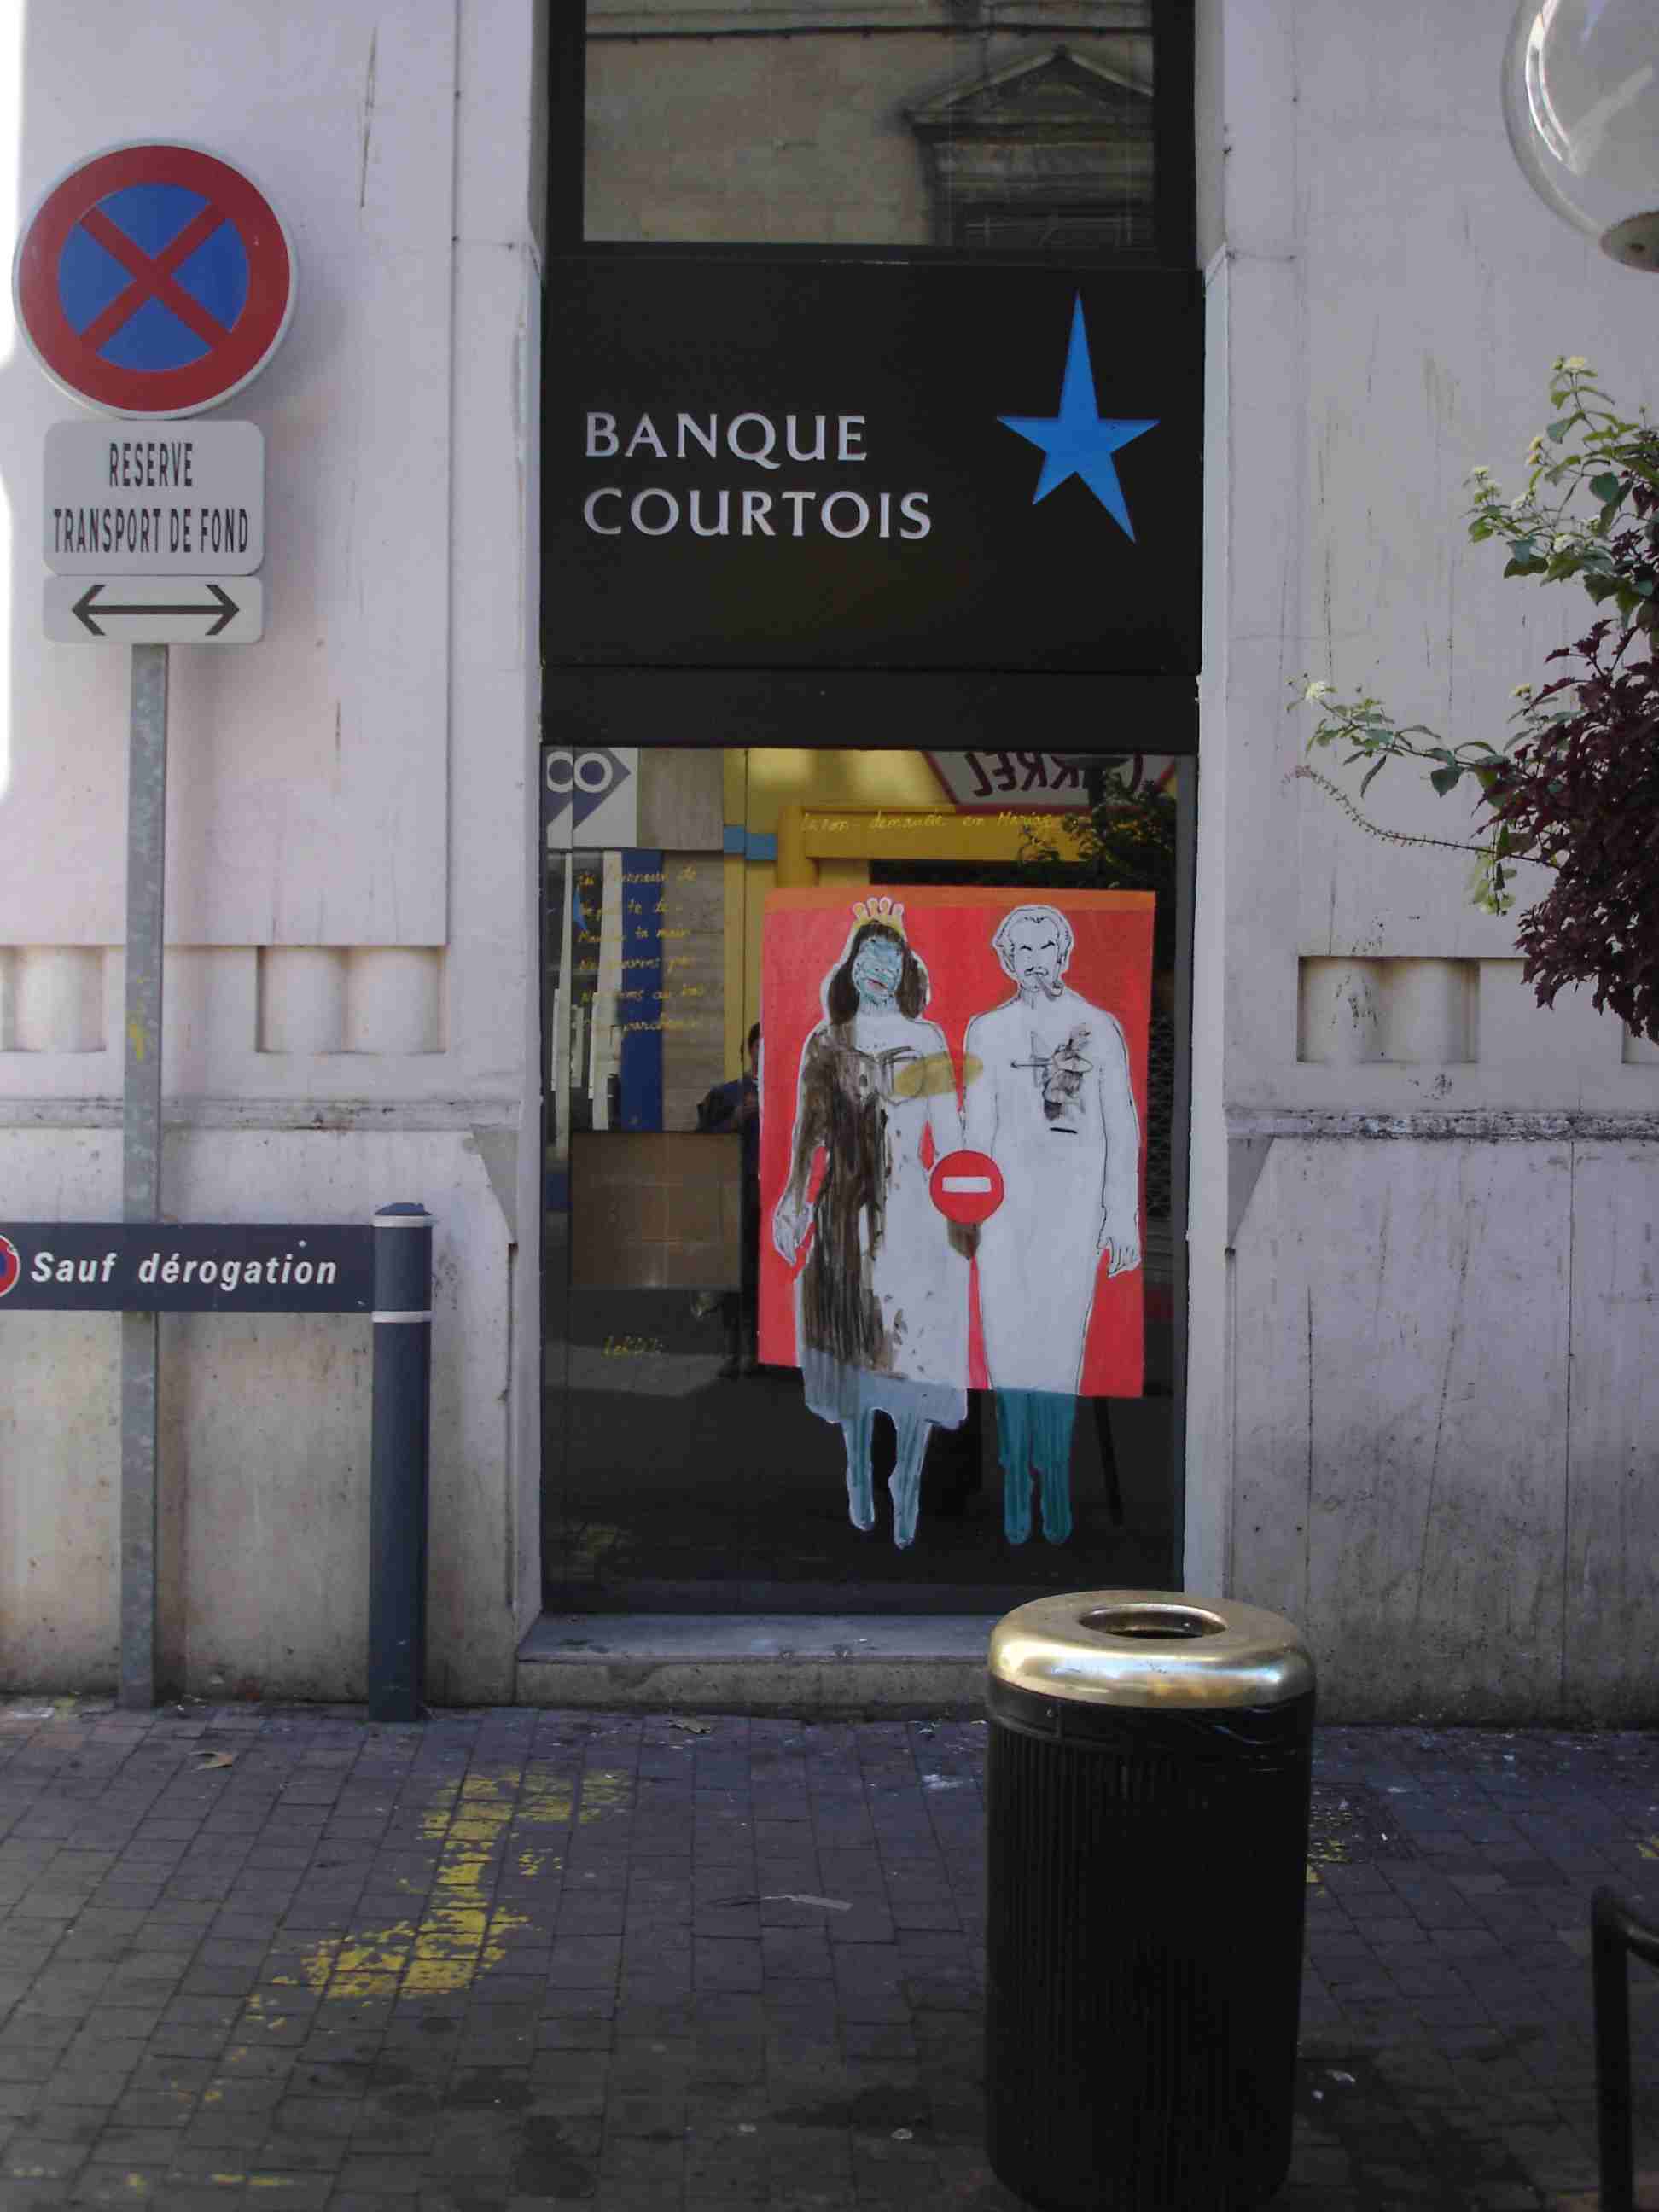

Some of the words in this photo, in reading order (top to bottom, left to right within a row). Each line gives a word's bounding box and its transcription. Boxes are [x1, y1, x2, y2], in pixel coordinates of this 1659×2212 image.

[585, 411, 867, 469] BANQUE
[109, 442, 194, 487] RESERVE
[54, 508, 162, 554] TRANSPORT
[170, 508, 192, 554] DE
[200, 508, 249, 554] FOND
[584, 487, 933, 540] COURTOIS
[31, 1251, 117, 1283] Sauf
[138, 1252, 338, 1292] dérogation
